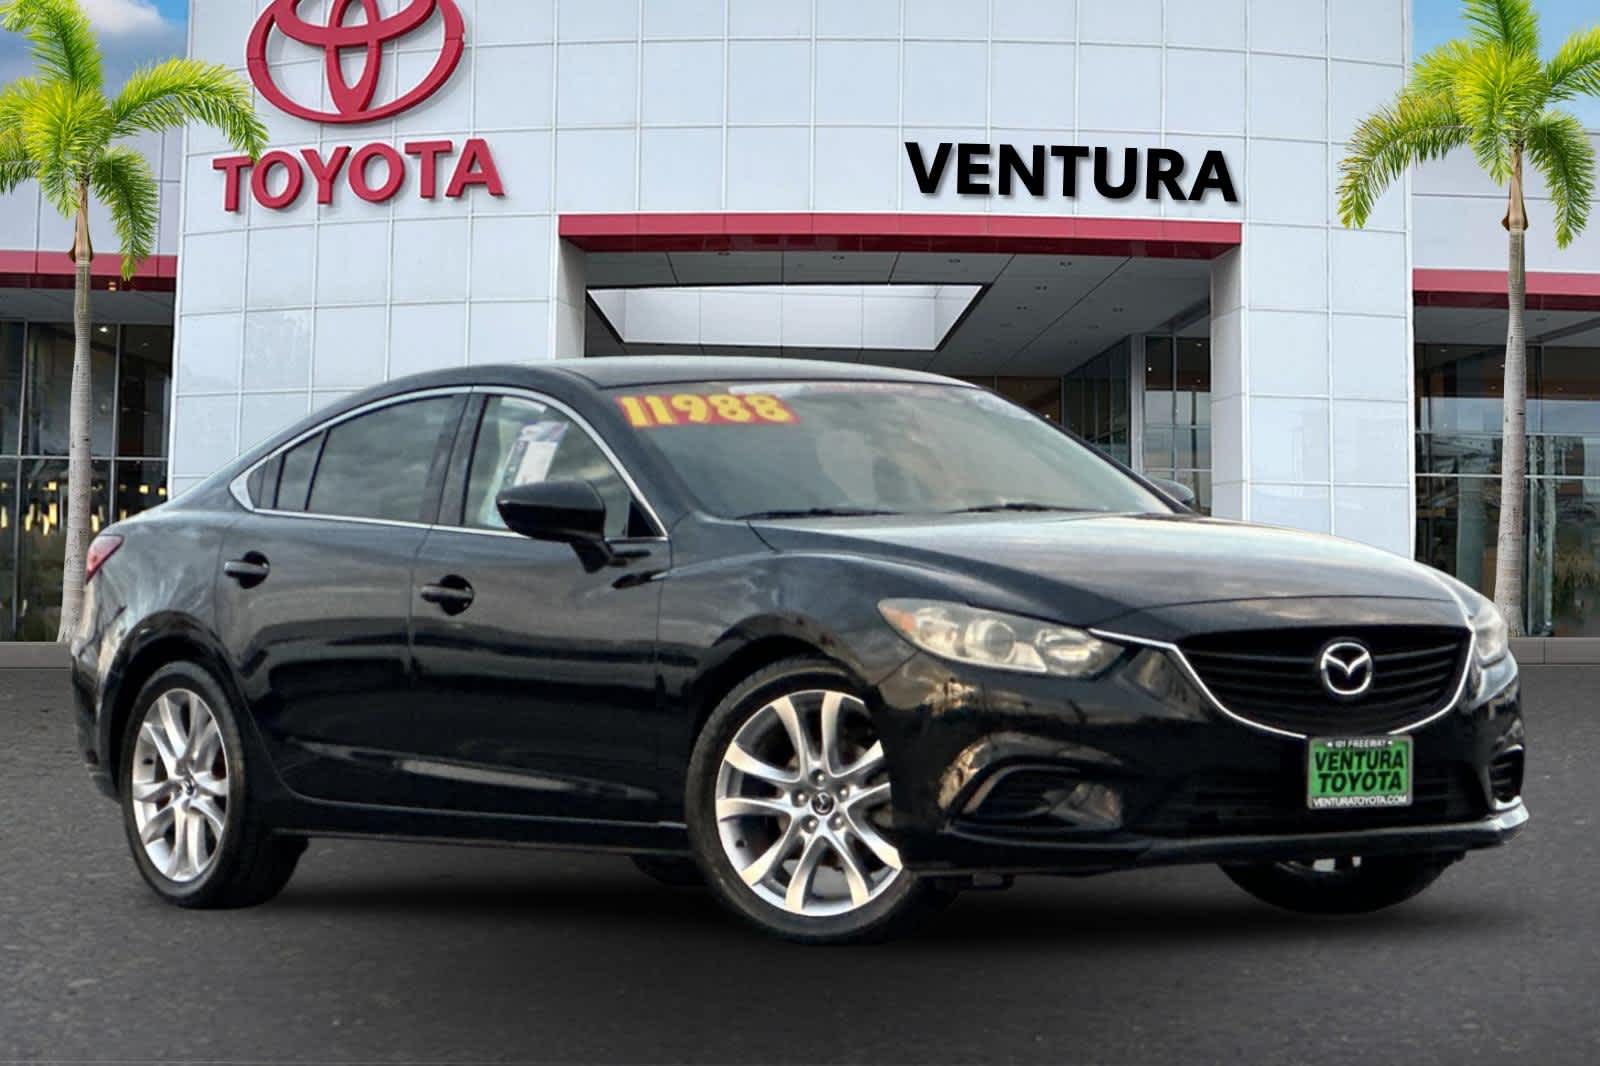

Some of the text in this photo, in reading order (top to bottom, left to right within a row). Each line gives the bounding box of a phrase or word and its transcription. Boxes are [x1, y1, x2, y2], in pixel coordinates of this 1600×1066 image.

[213, 139, 504, 212] TOYOTA
[905, 142, 1238, 202] VENTURA
[620, 394, 792, 427] 11988
[1348, 739, 1386, 748] FREEWAY
[1315, 750, 1404, 771] VENTURA
[1318, 771, 1402, 793] TOYOTA
[1313, 795, 1407, 807] VENTURATOYOTA.COM
